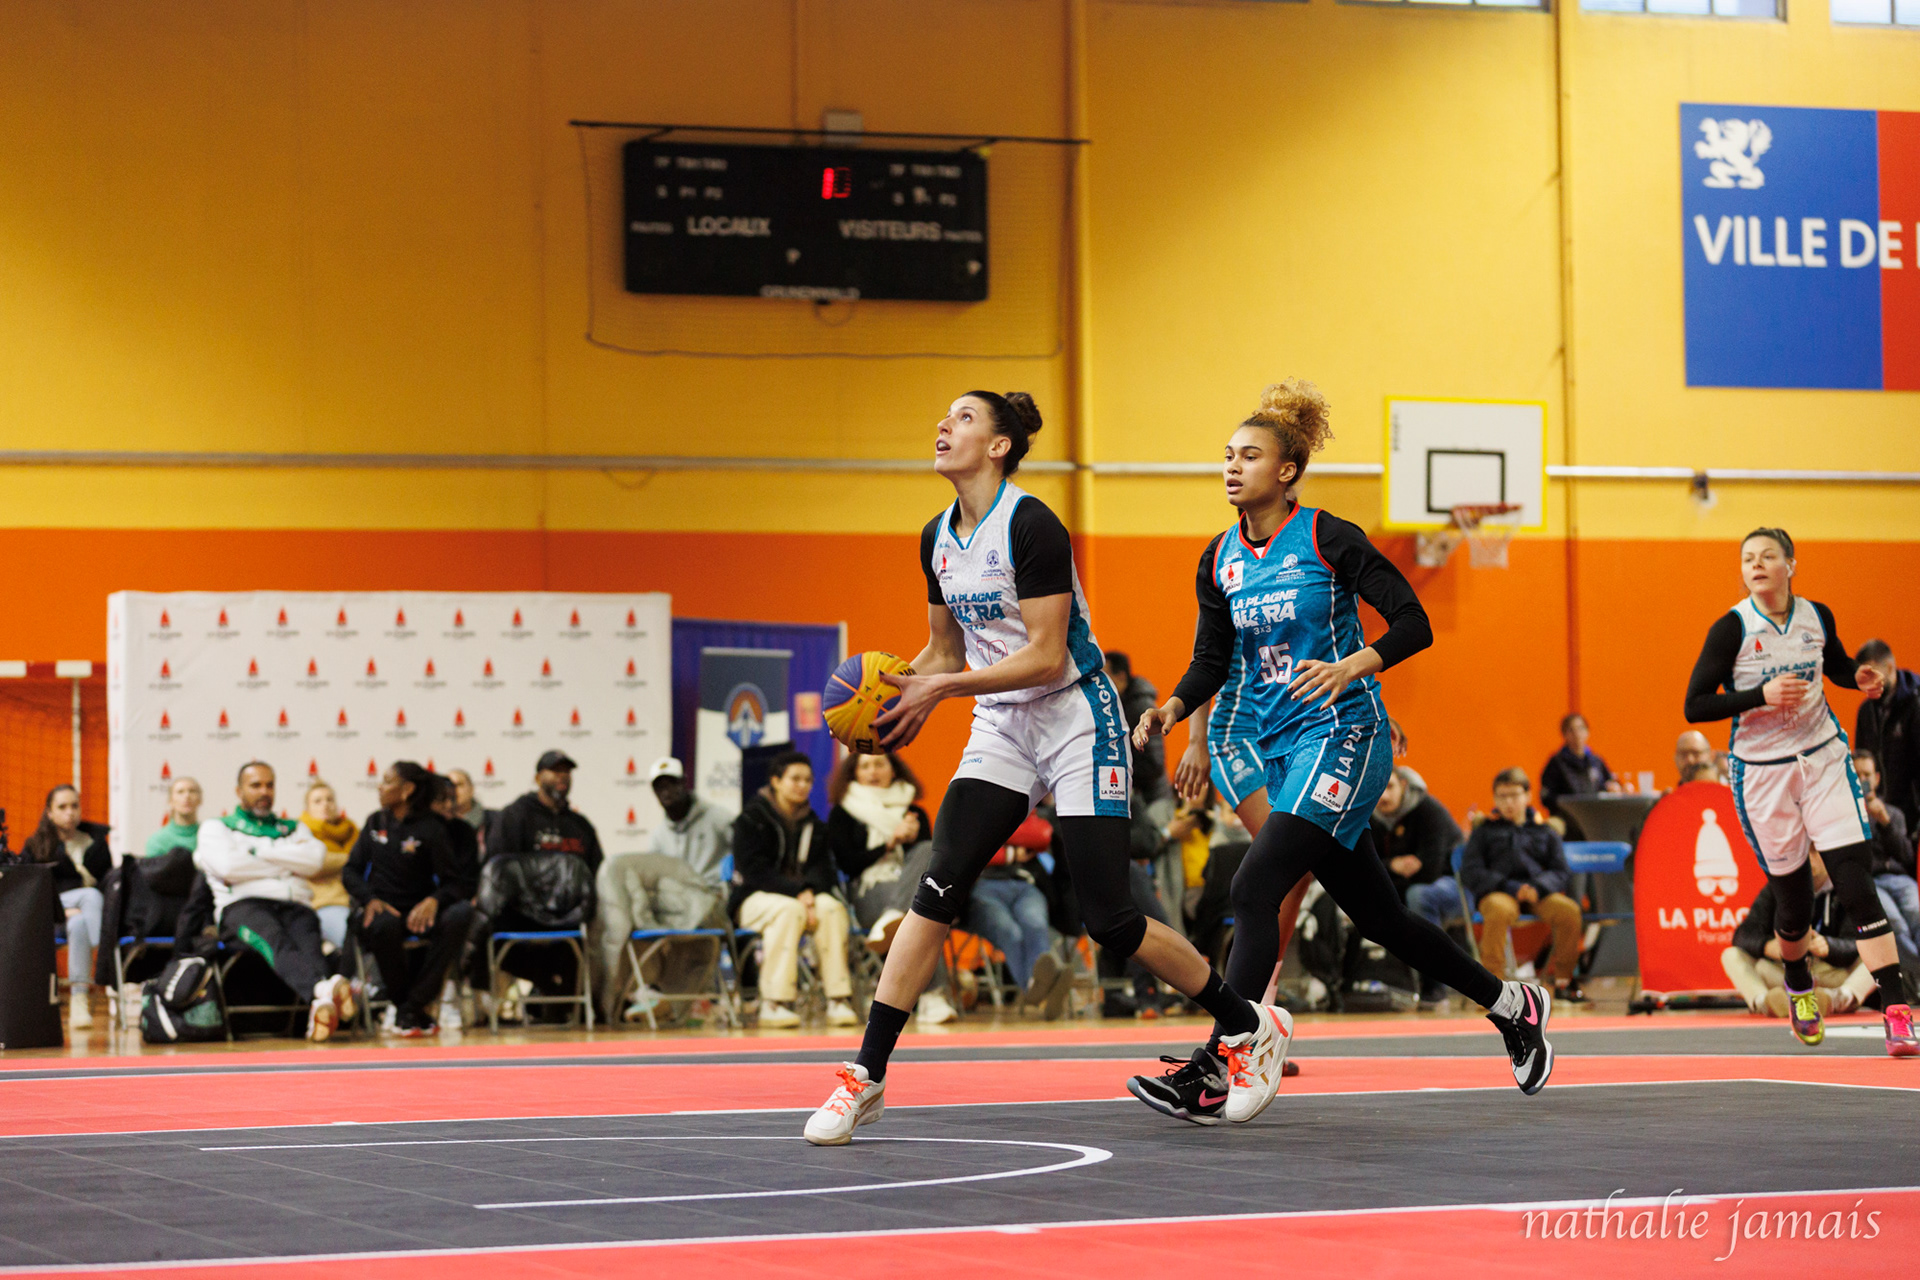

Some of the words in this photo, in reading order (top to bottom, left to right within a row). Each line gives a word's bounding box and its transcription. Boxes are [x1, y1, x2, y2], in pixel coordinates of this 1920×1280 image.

[687, 216, 771, 236] LOCAUX
[839, 220, 941, 240] VISITEURS
[1693, 214, 1828, 268] VILLE
[1839, 219, 1904, 269] DE
[946, 594, 957, 604] LA
[958, 591, 1003, 604] PLAGNE
[1232, 599, 1244, 611] LA
[1245, 589, 1299, 608] PLAGNE
[1258, 642, 1293, 684] 35
[1762, 666, 1776, 676] LA
[1778, 660, 1818, 674] PLAGNE
[1335, 756, 1354, 778] LA
[1657, 907, 1689, 929] LA
